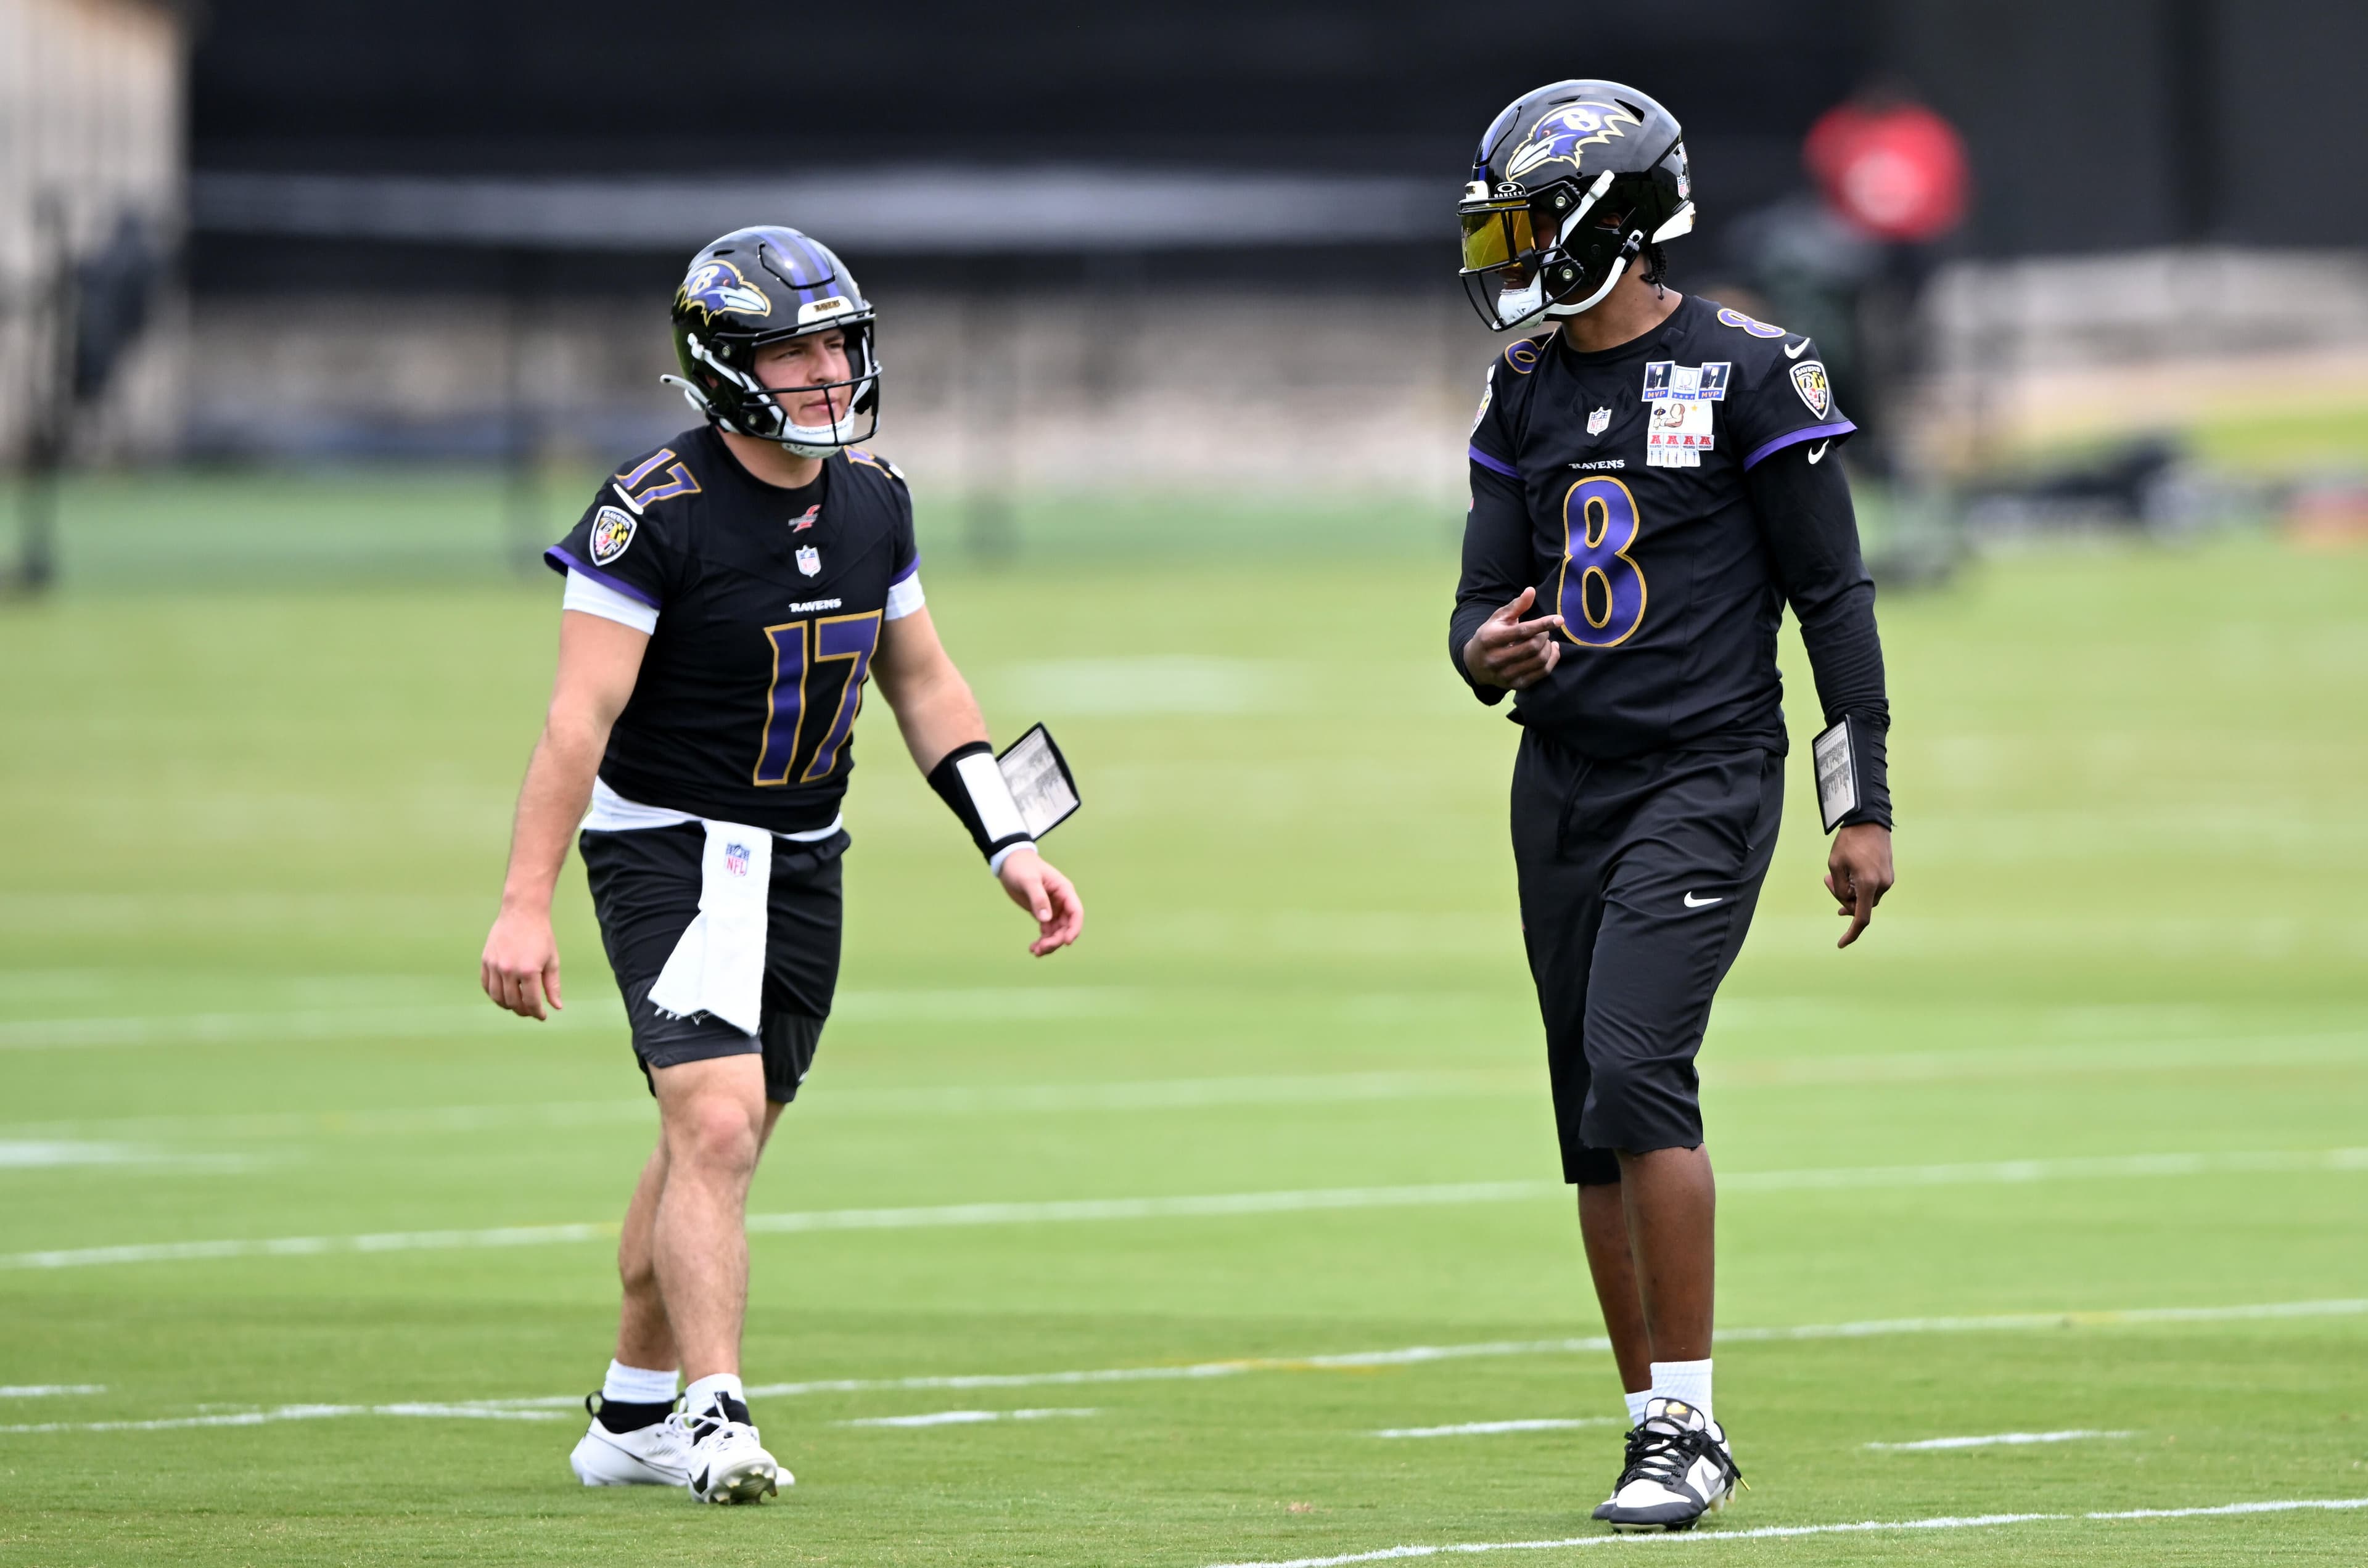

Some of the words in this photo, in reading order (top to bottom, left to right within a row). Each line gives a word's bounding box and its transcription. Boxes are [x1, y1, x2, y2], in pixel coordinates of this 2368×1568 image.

[687, 265, 720, 297] B
[1717, 308, 1786, 339] 8
[1794, 366, 1821, 377] RAVENS
[1647, 390, 1666, 398] MVP
[1701, 390, 1720, 398] MVP
[1591, 419, 1605, 430] NFL
[1568, 459, 1625, 470] RAVENS
[614, 448, 702, 509] 17
[602, 511, 630, 530] RAVENS
[1557, 475, 1647, 648] 8
[789, 598, 842, 613] RAVENS
[753, 609, 882, 787] 17
[726, 857, 746, 874] NFL
